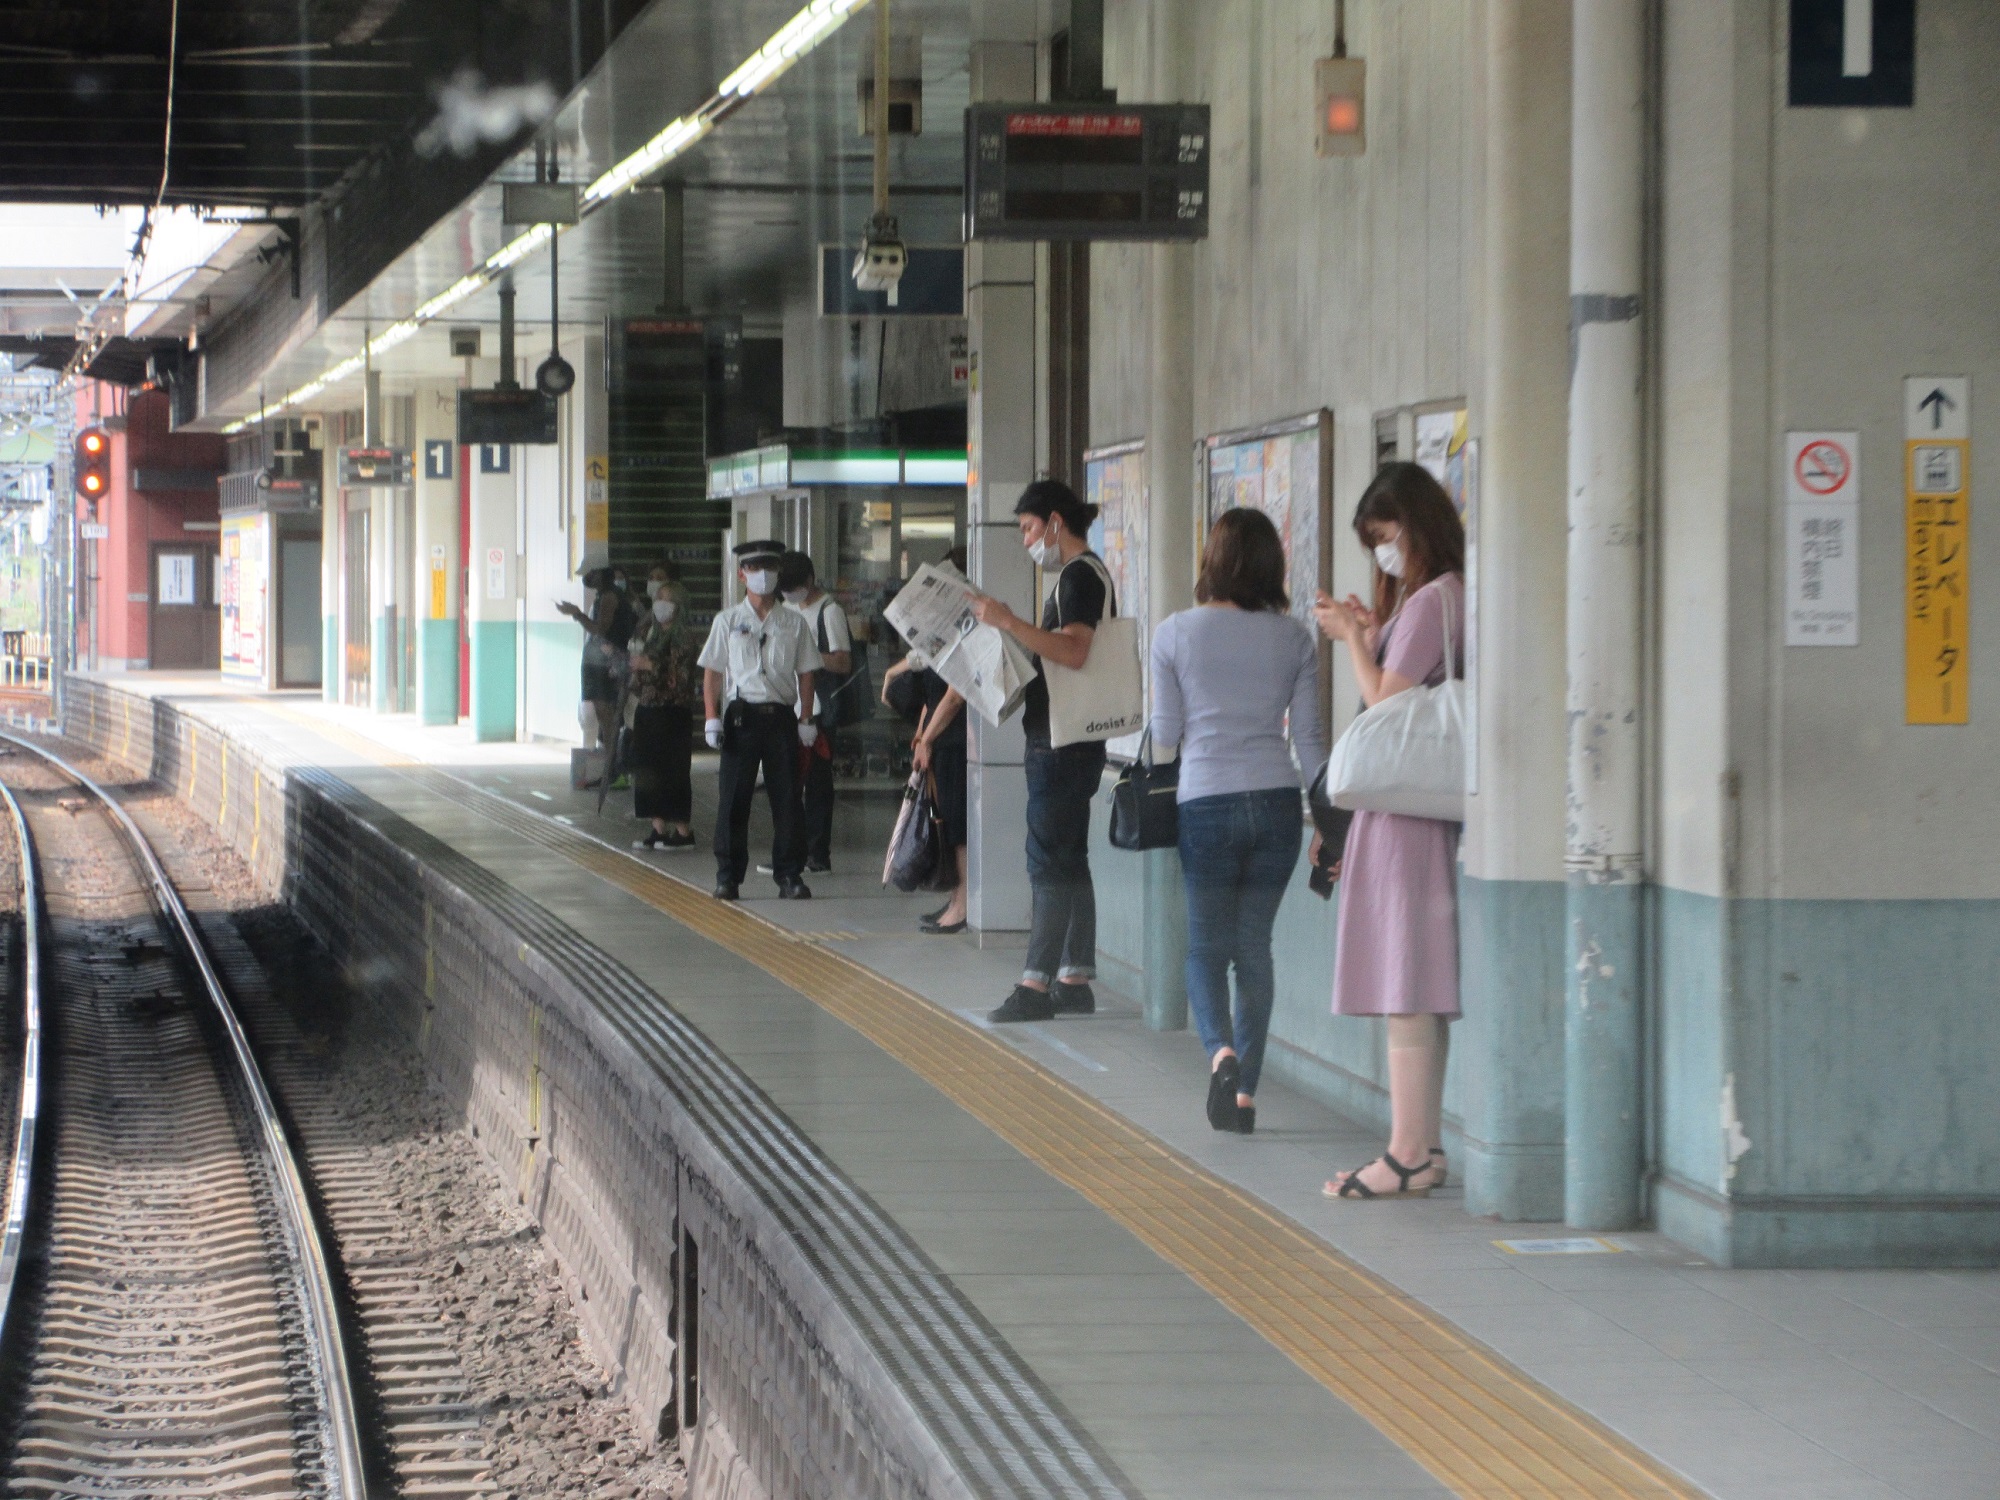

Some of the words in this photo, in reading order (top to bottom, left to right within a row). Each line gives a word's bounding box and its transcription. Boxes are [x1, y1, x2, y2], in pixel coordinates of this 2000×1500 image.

[430, 444, 444, 474] 1
[485, 443, 501, 468] 1
[1936, 498, 1961, 715] エレベーター
[1086, 716, 1125, 735] dosist
